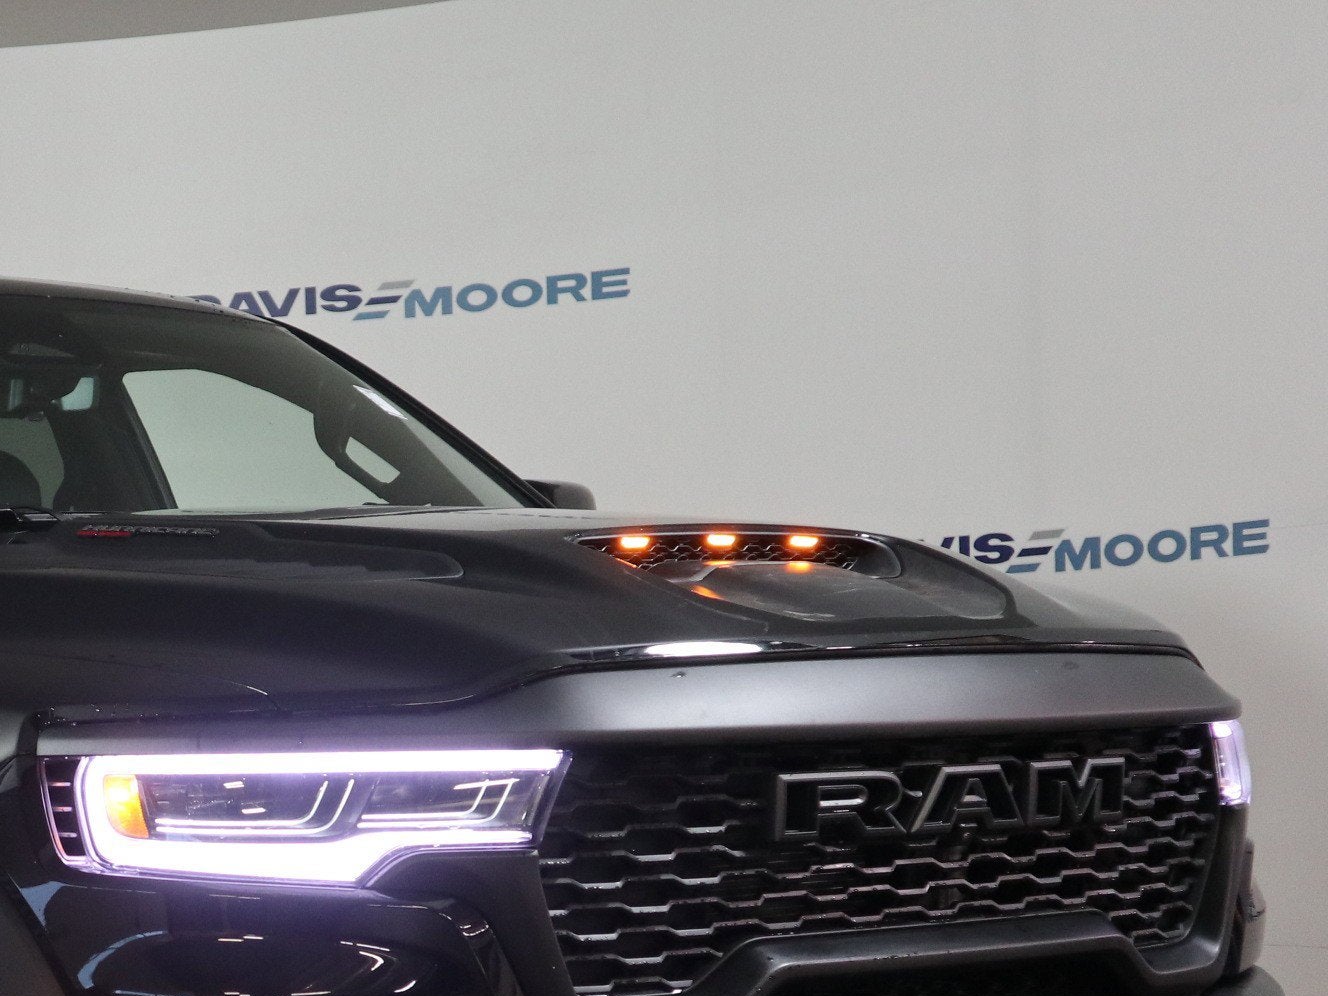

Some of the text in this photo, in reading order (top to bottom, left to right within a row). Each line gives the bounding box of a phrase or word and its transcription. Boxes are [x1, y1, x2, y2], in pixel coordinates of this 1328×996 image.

[187, 267, 631, 319] AVIS MOORE
[1055, 519, 1270, 573] MOORE
[777, 757, 1126, 840] RAM
